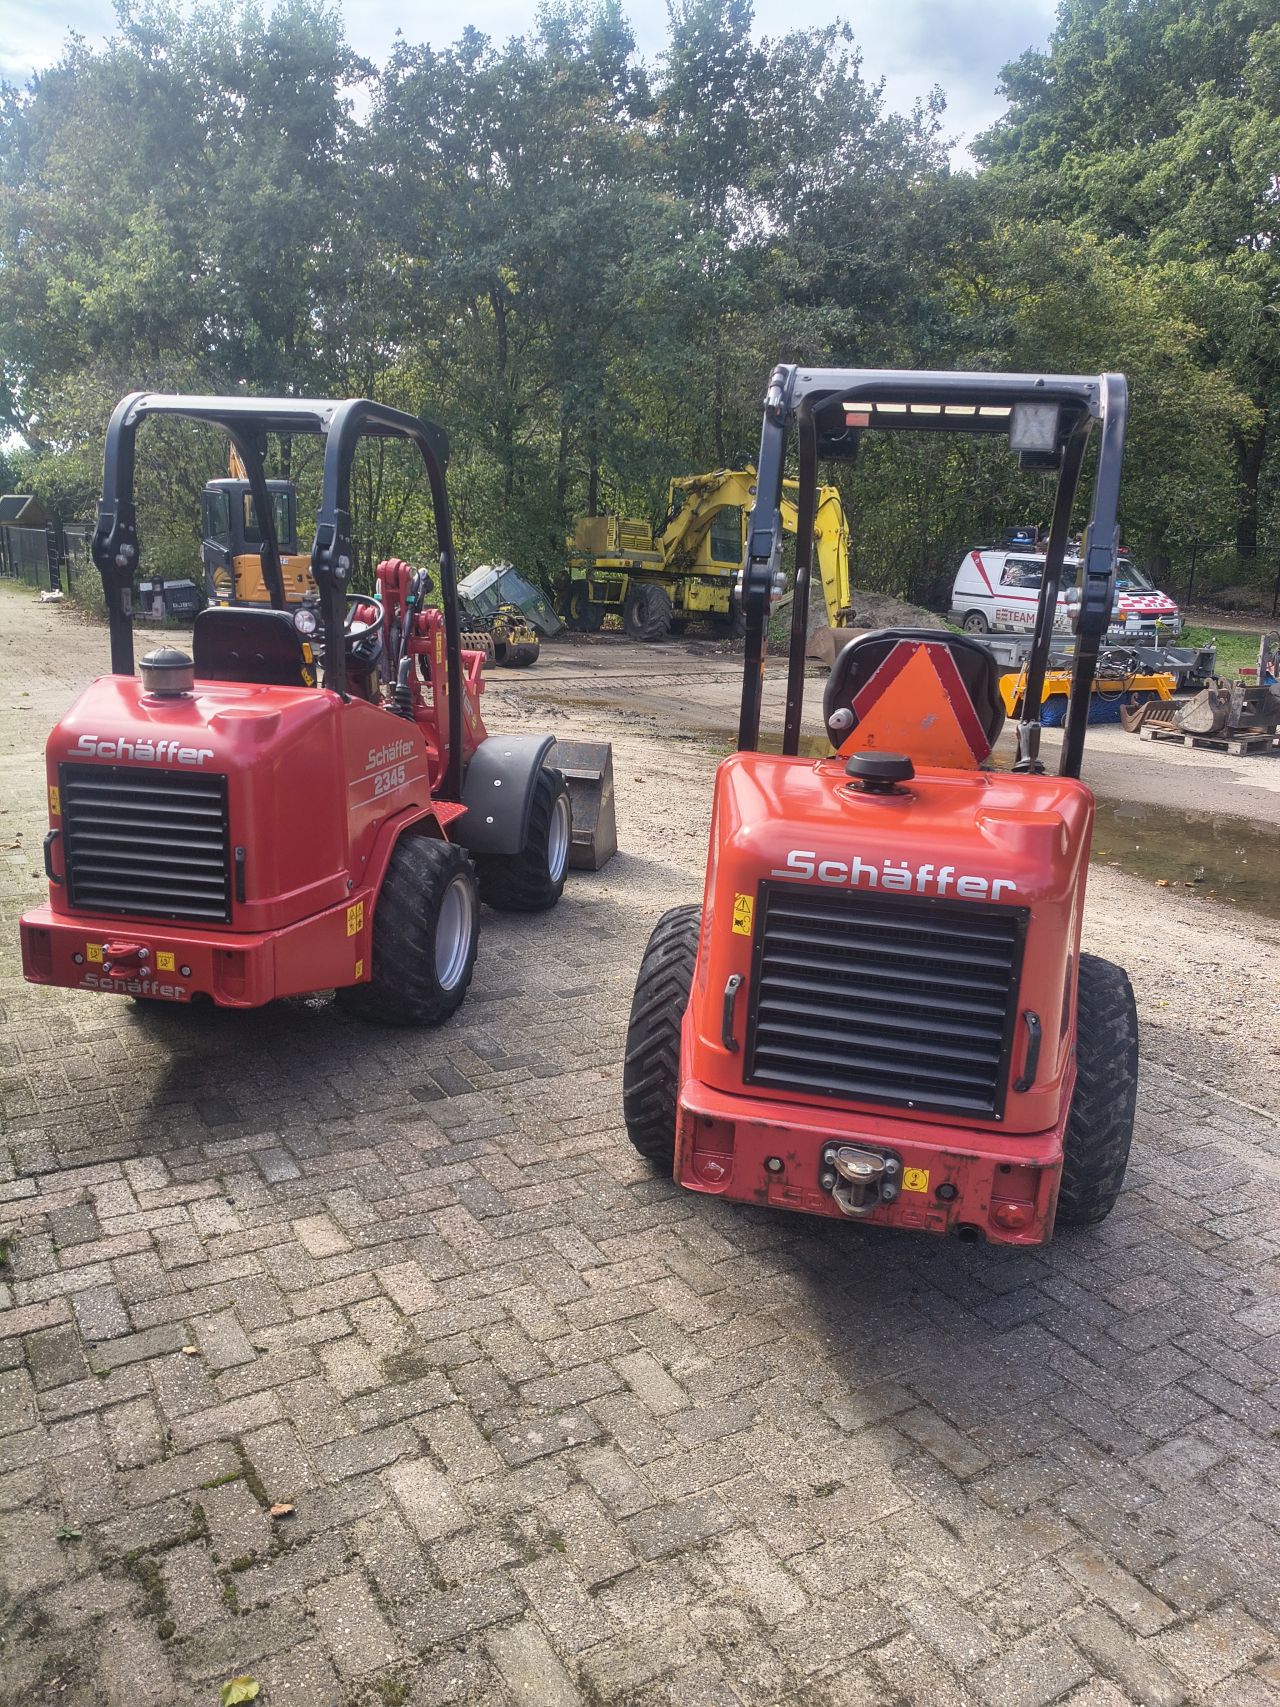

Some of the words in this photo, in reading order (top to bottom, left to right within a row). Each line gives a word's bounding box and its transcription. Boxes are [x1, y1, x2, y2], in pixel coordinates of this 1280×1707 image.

[67, 734, 214, 765] Schäffer
[365, 739, 414, 771] Schäffer
[374, 764, 405, 796] 2345
[771, 850, 1017, 900] Schäffer
[80, 972, 185, 999] Schäffer
